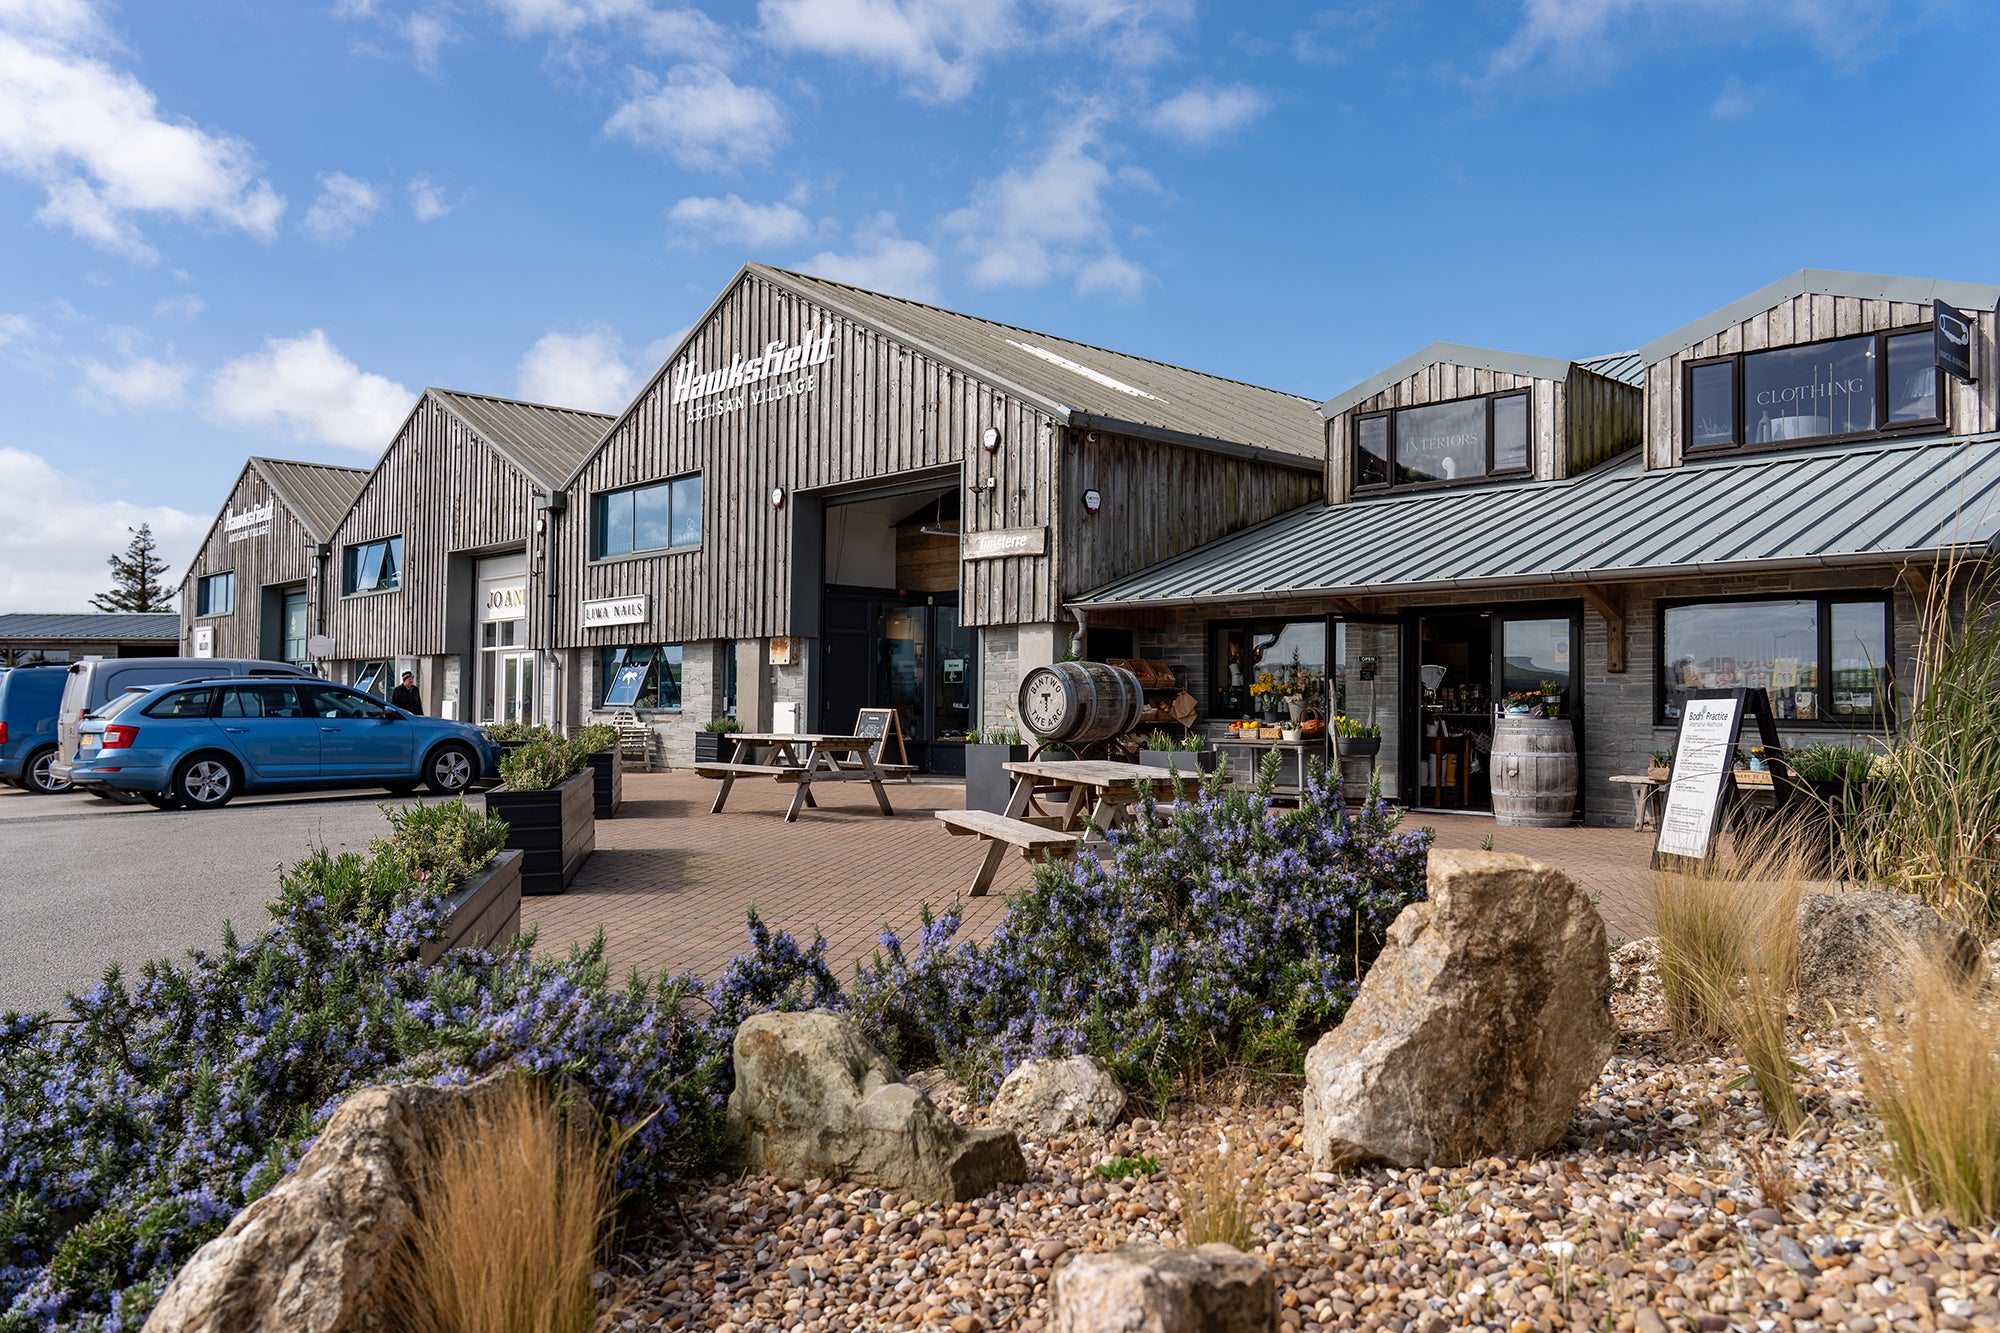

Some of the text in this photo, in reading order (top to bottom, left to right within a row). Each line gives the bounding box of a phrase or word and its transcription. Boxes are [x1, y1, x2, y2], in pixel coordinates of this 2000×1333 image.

[673, 323, 834, 405] Hawksfield
[686, 374, 817, 424] ARTISAN VILLAGE
[1756, 378, 1864, 405] CLOTHING
[1405, 432, 1479, 455] INTERIORS
[979, 534, 1027, 551] finisterre
[487, 591, 503, 609] JO
[613, 603, 643, 617] NAILS
[1031, 708, 1046, 727] THE
[1706, 711, 1729, 721] Practice
